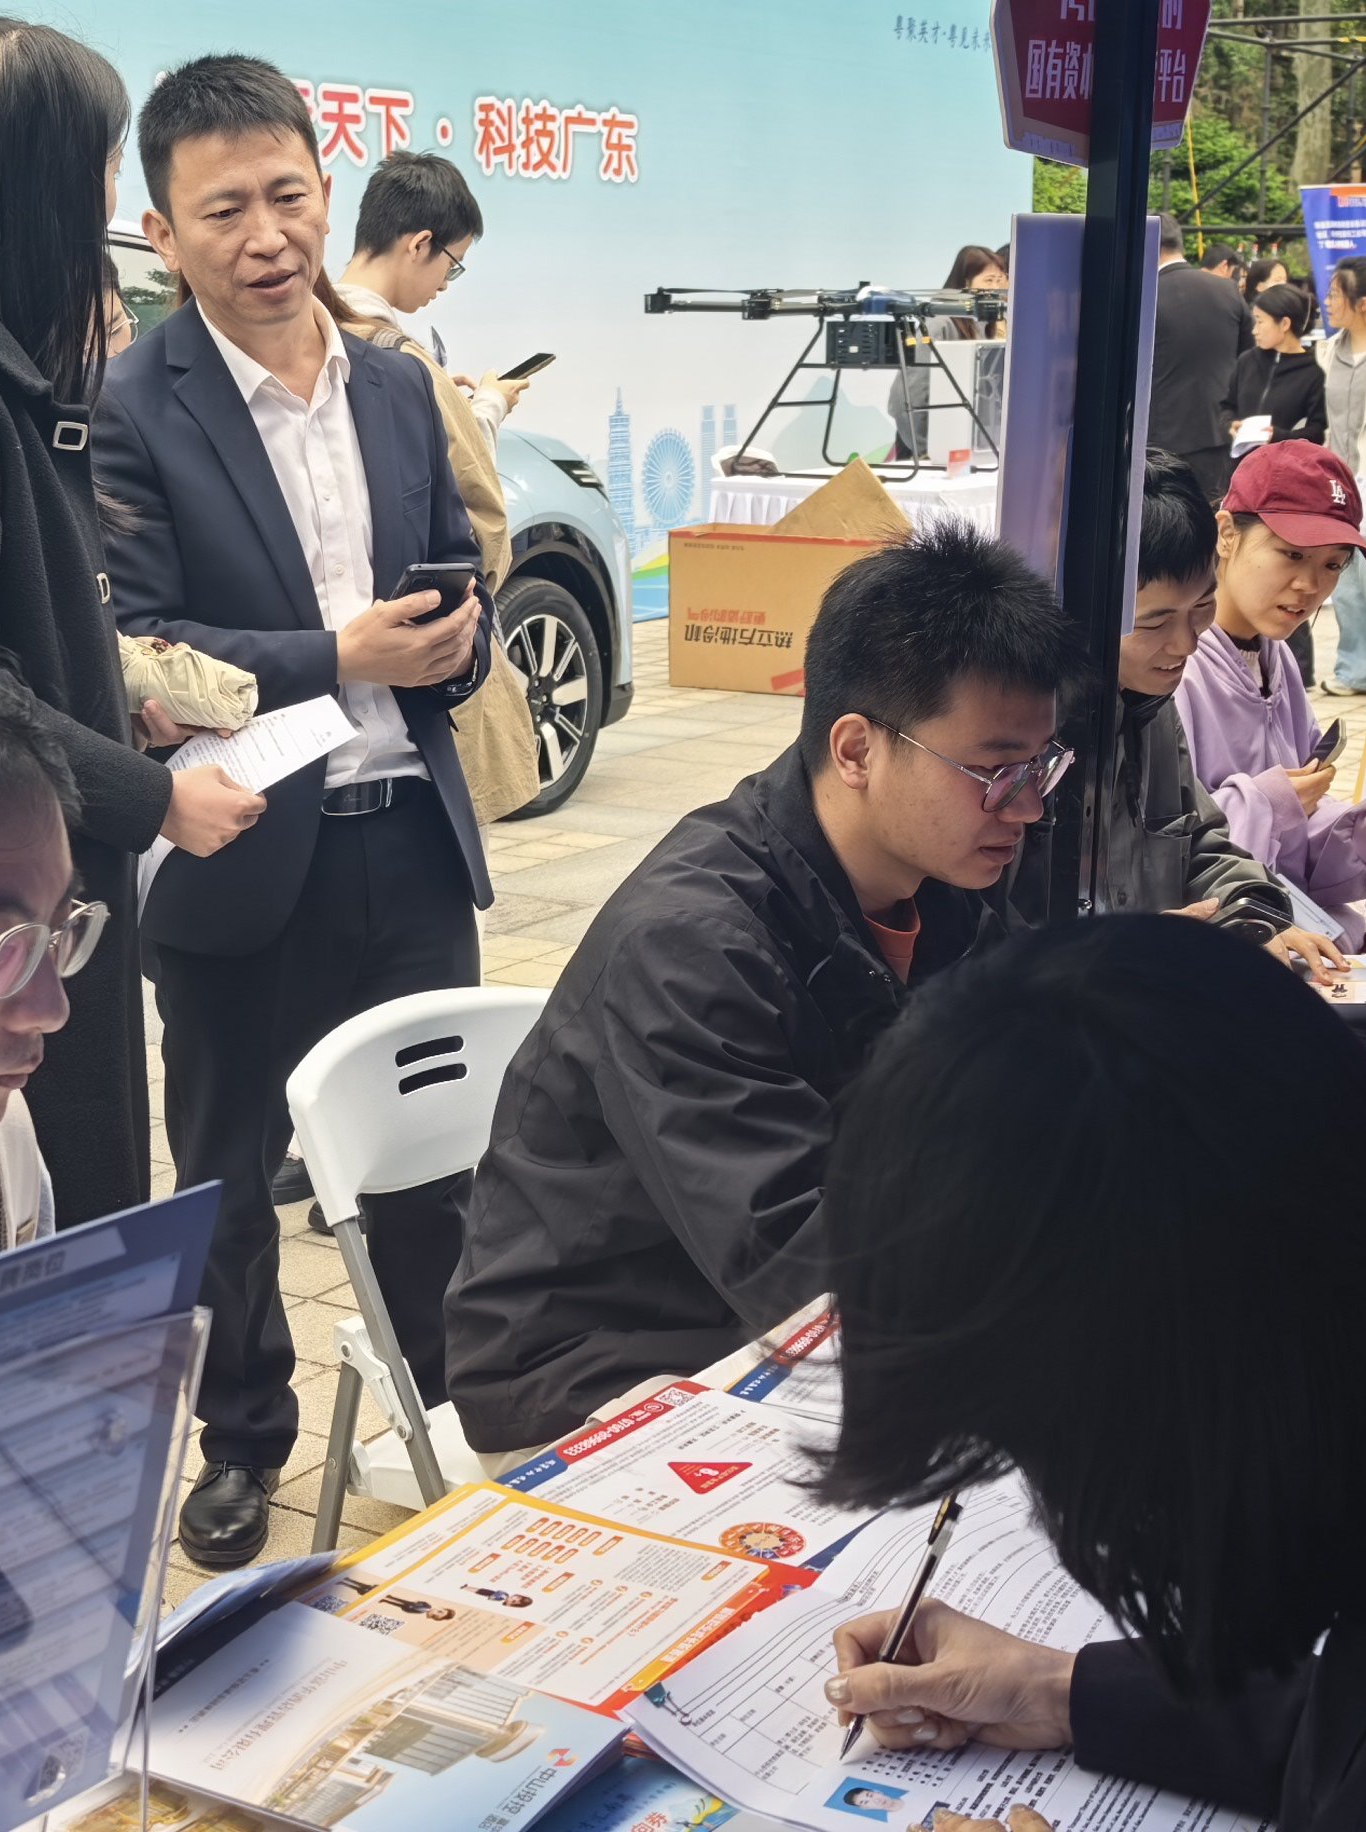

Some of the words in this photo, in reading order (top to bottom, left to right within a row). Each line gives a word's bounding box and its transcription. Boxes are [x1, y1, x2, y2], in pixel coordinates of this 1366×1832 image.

[297, 80, 639, 182] 天下·科技广东
[1329, 480, 1346, 505] LA
[684, 624, 794, 649] 热立方地冷机
